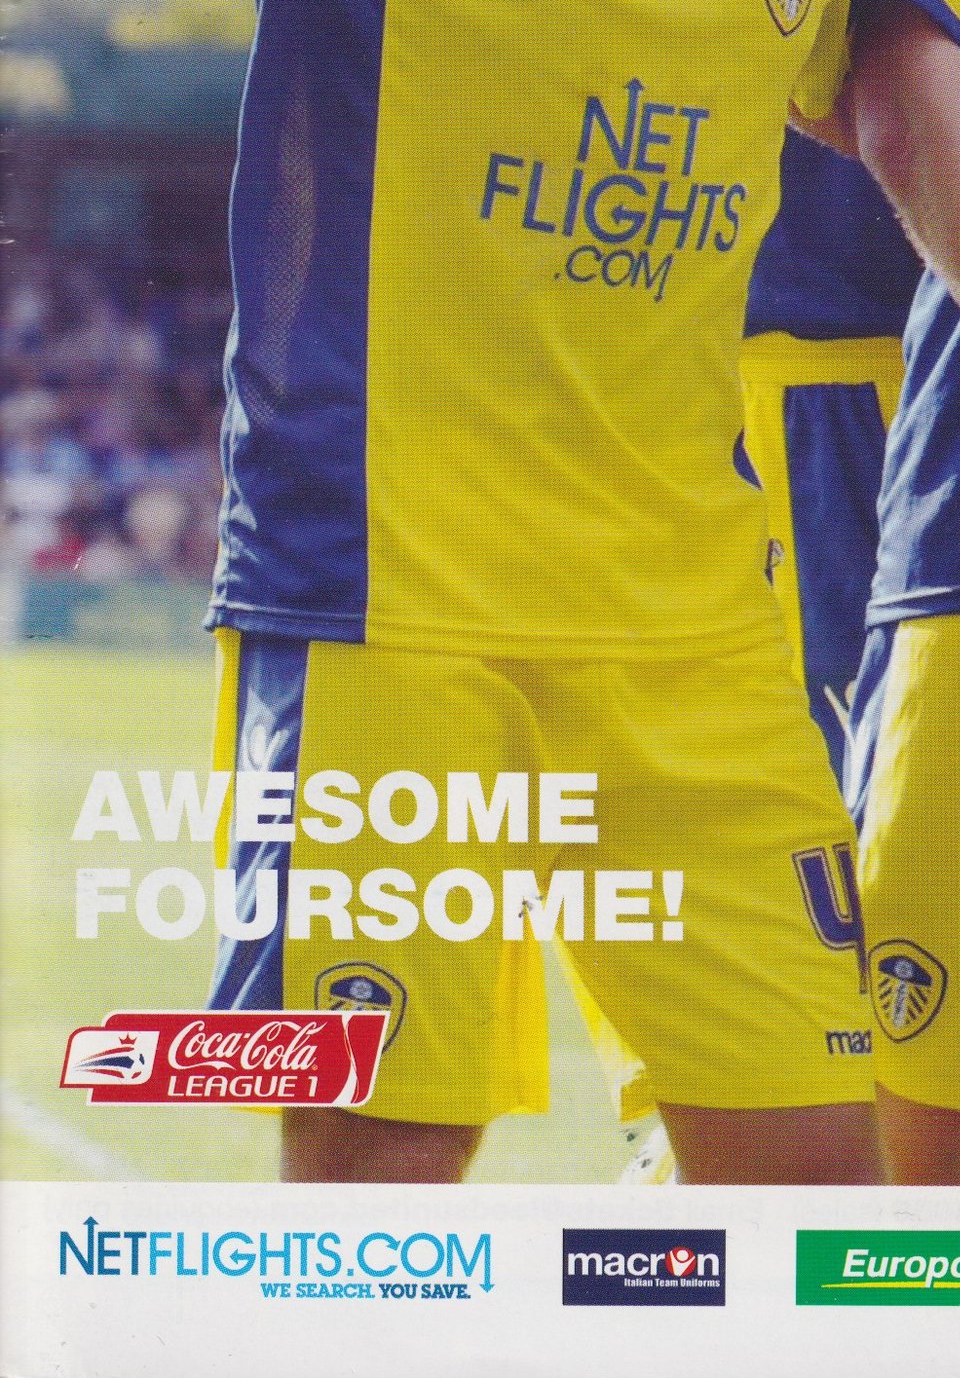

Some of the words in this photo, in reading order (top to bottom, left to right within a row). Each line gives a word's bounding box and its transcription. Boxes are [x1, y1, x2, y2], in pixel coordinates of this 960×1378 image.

[577, 79, 709, 177] NET
[480, 152, 747, 253] FLIGHTS
[71, 770, 598, 844] AWESOME
[75, 868, 684, 941] FOURSOME!
[168, 1020, 328, 1071] Coca-Cola
[167, 1075, 298, 1098] LEAGUE
[308, 1075, 319, 1098] 1
[59, 1216, 495, 1294] NETFLIGHTS.COM
[567, 1246, 720, 1277] macron
[624, 1278, 653, 1288] Italian
[655, 1278, 678, 1288] Team
[680, 1278, 721, 1288] Uniforms
[261, 1283, 291, 1298] WE
[296, 1283, 375, 1299] SEARCH.
[381, 1283, 416, 1299] YOU
[421, 1284, 471, 1300] SAVE.
